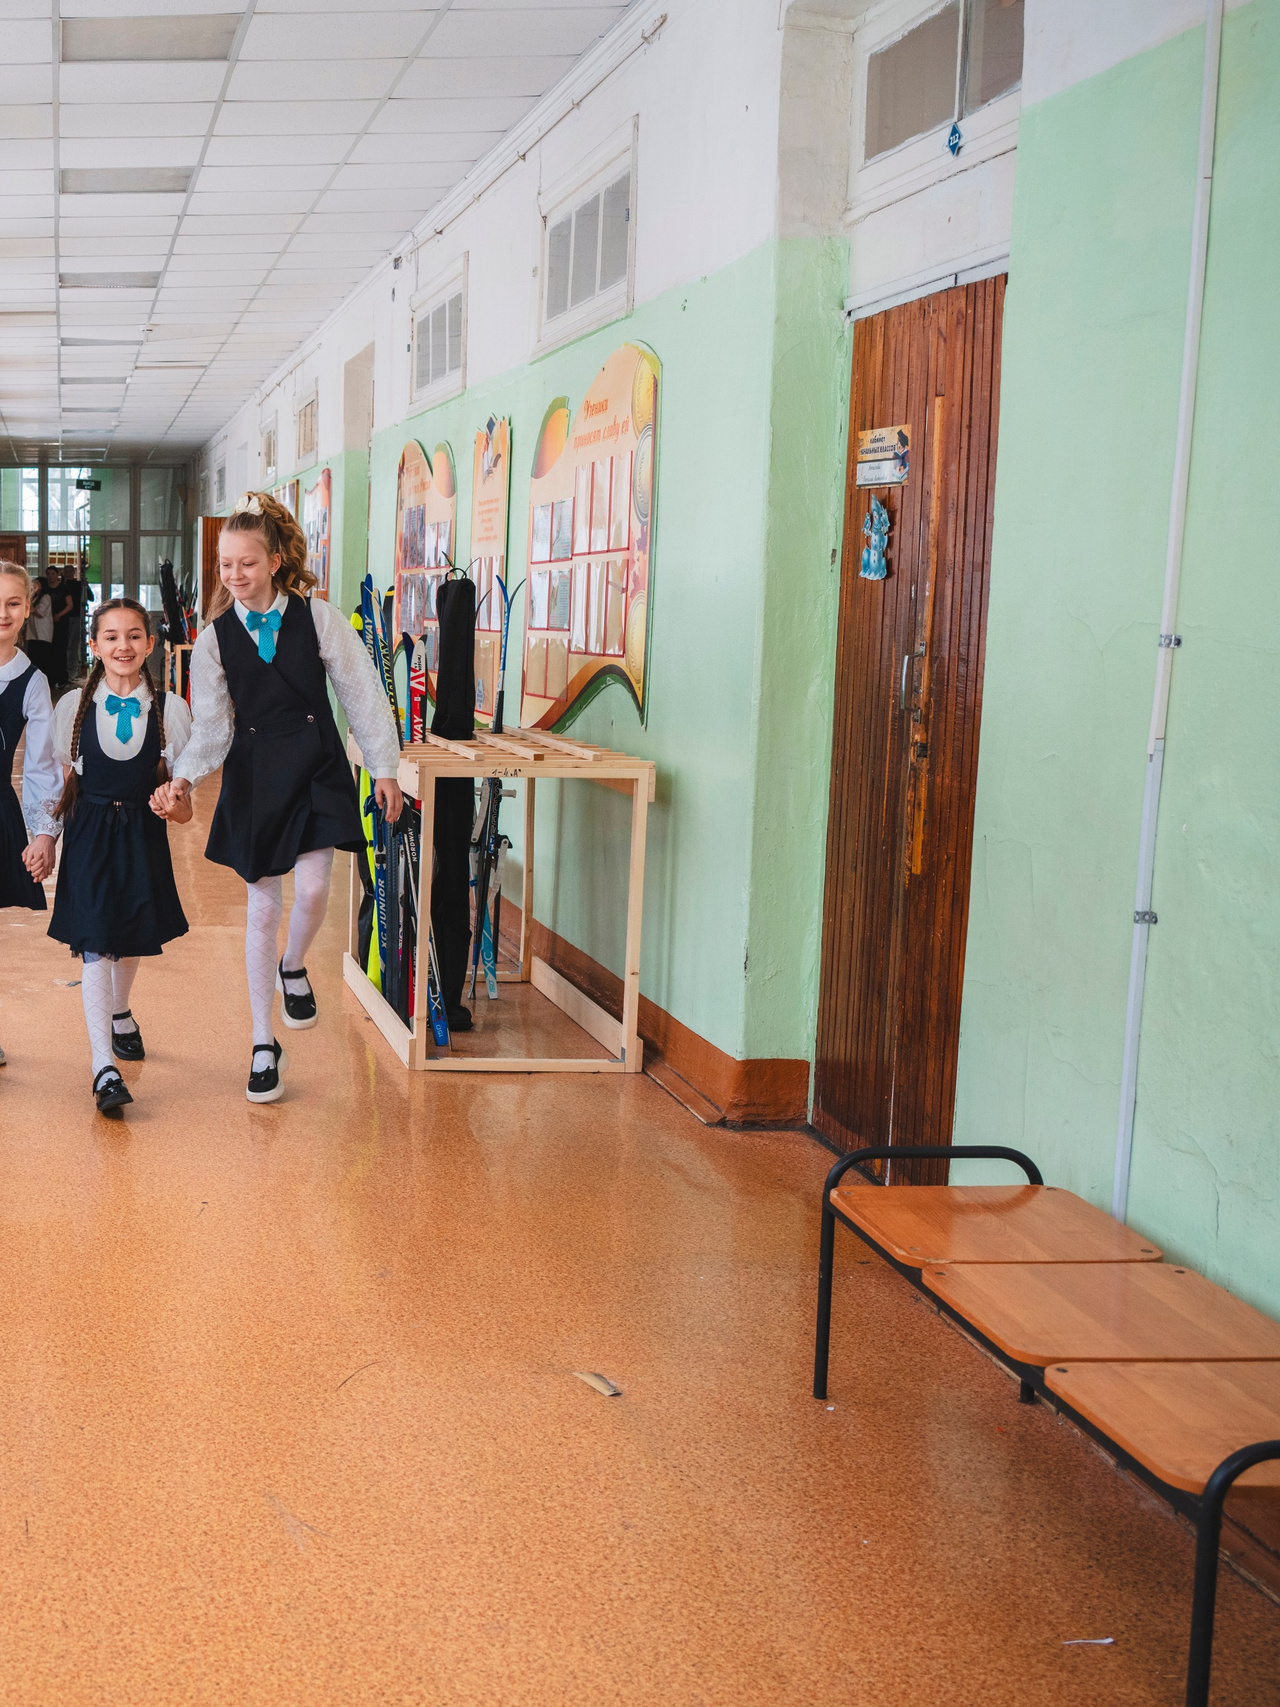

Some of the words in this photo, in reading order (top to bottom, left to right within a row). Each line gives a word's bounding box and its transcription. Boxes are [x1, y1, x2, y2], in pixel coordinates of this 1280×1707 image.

[949, 133, 959, 146] 212
[584, 398, 609, 420] Ученики
[364, 614, 374, 661] DWAY
[376, 633, 396, 709] RDWAY
[407, 827, 418, 862] NORDWAY
[378, 878, 388, 929] JUNIOR
[380, 931, 388, 949] XC
[483, 951, 495, 969] XC
[429, 986, 442, 1011] XC
